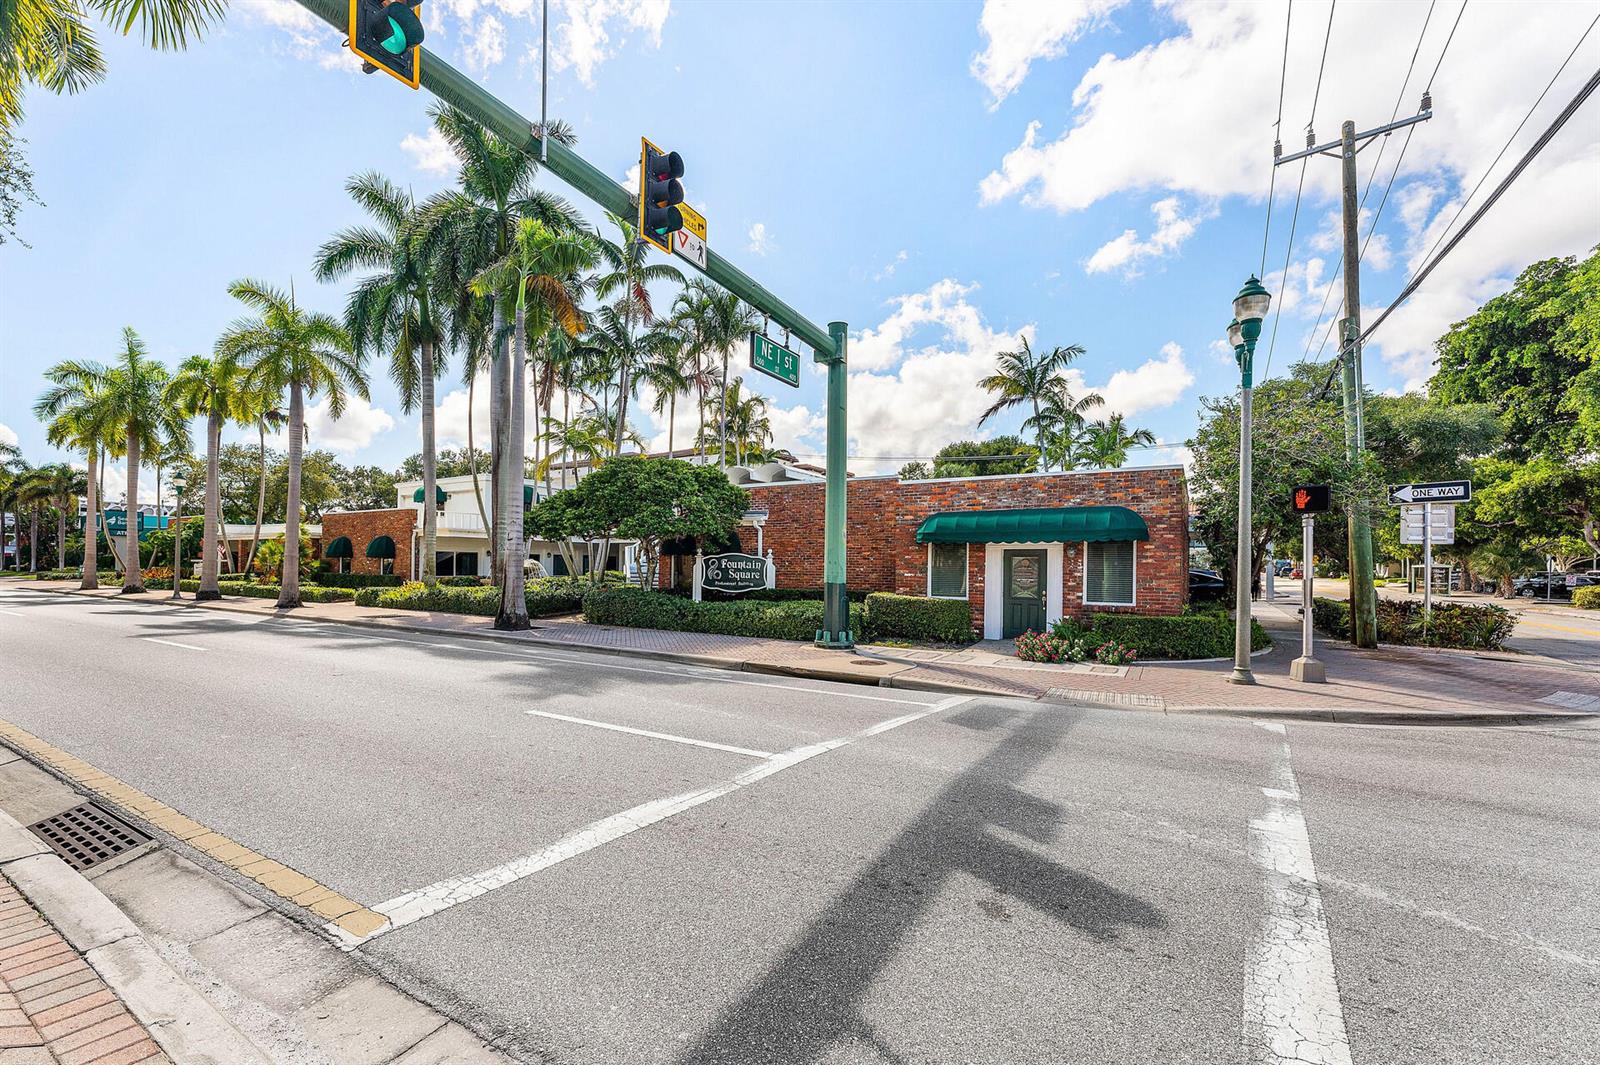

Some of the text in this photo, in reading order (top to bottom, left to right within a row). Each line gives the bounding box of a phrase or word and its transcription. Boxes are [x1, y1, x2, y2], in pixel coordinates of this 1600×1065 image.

[689, 242, 695, 251] TO
[761, 340, 774, 361] NE
[1412, 487, 1461, 498] ONE WAY
[720, 558, 762, 571] Fountain
[728, 568, 761, 581] Square
